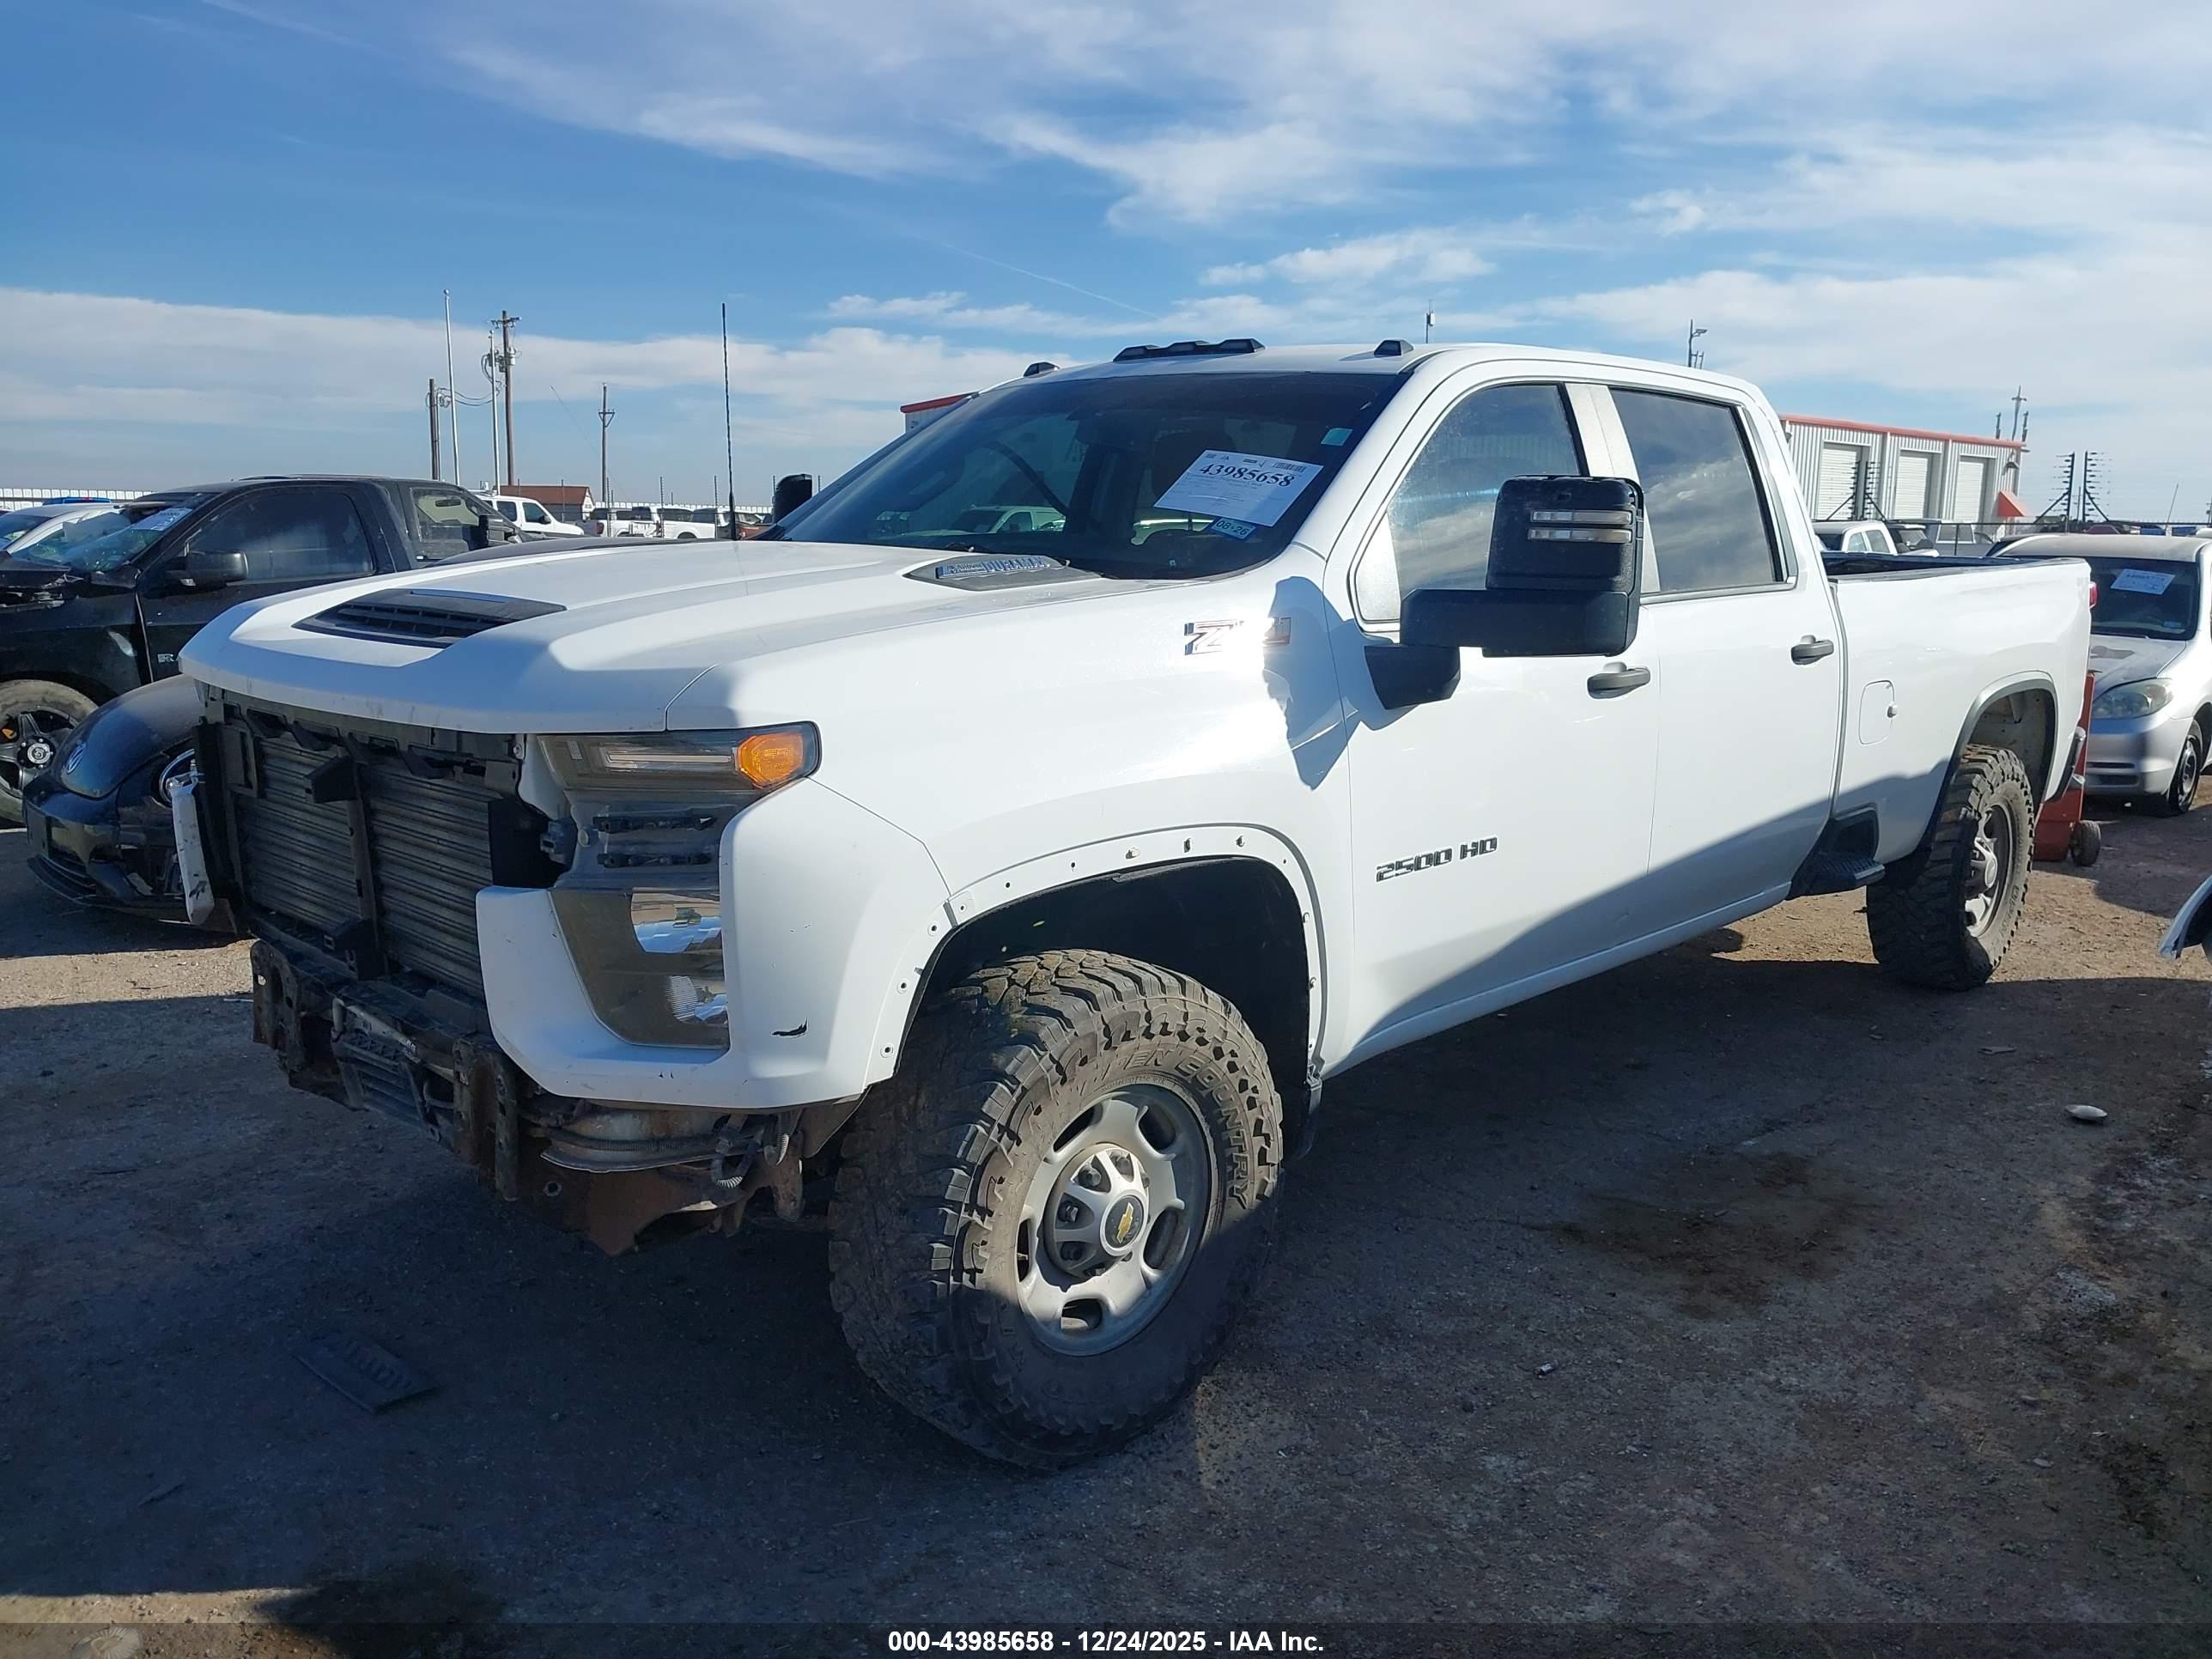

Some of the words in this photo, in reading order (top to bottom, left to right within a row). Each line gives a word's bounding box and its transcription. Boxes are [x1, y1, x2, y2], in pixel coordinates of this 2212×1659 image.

[1200, 463, 1295, 487] 43985658
[1376, 848, 1453, 883] 2500
[1460, 836, 1498, 860] HD
